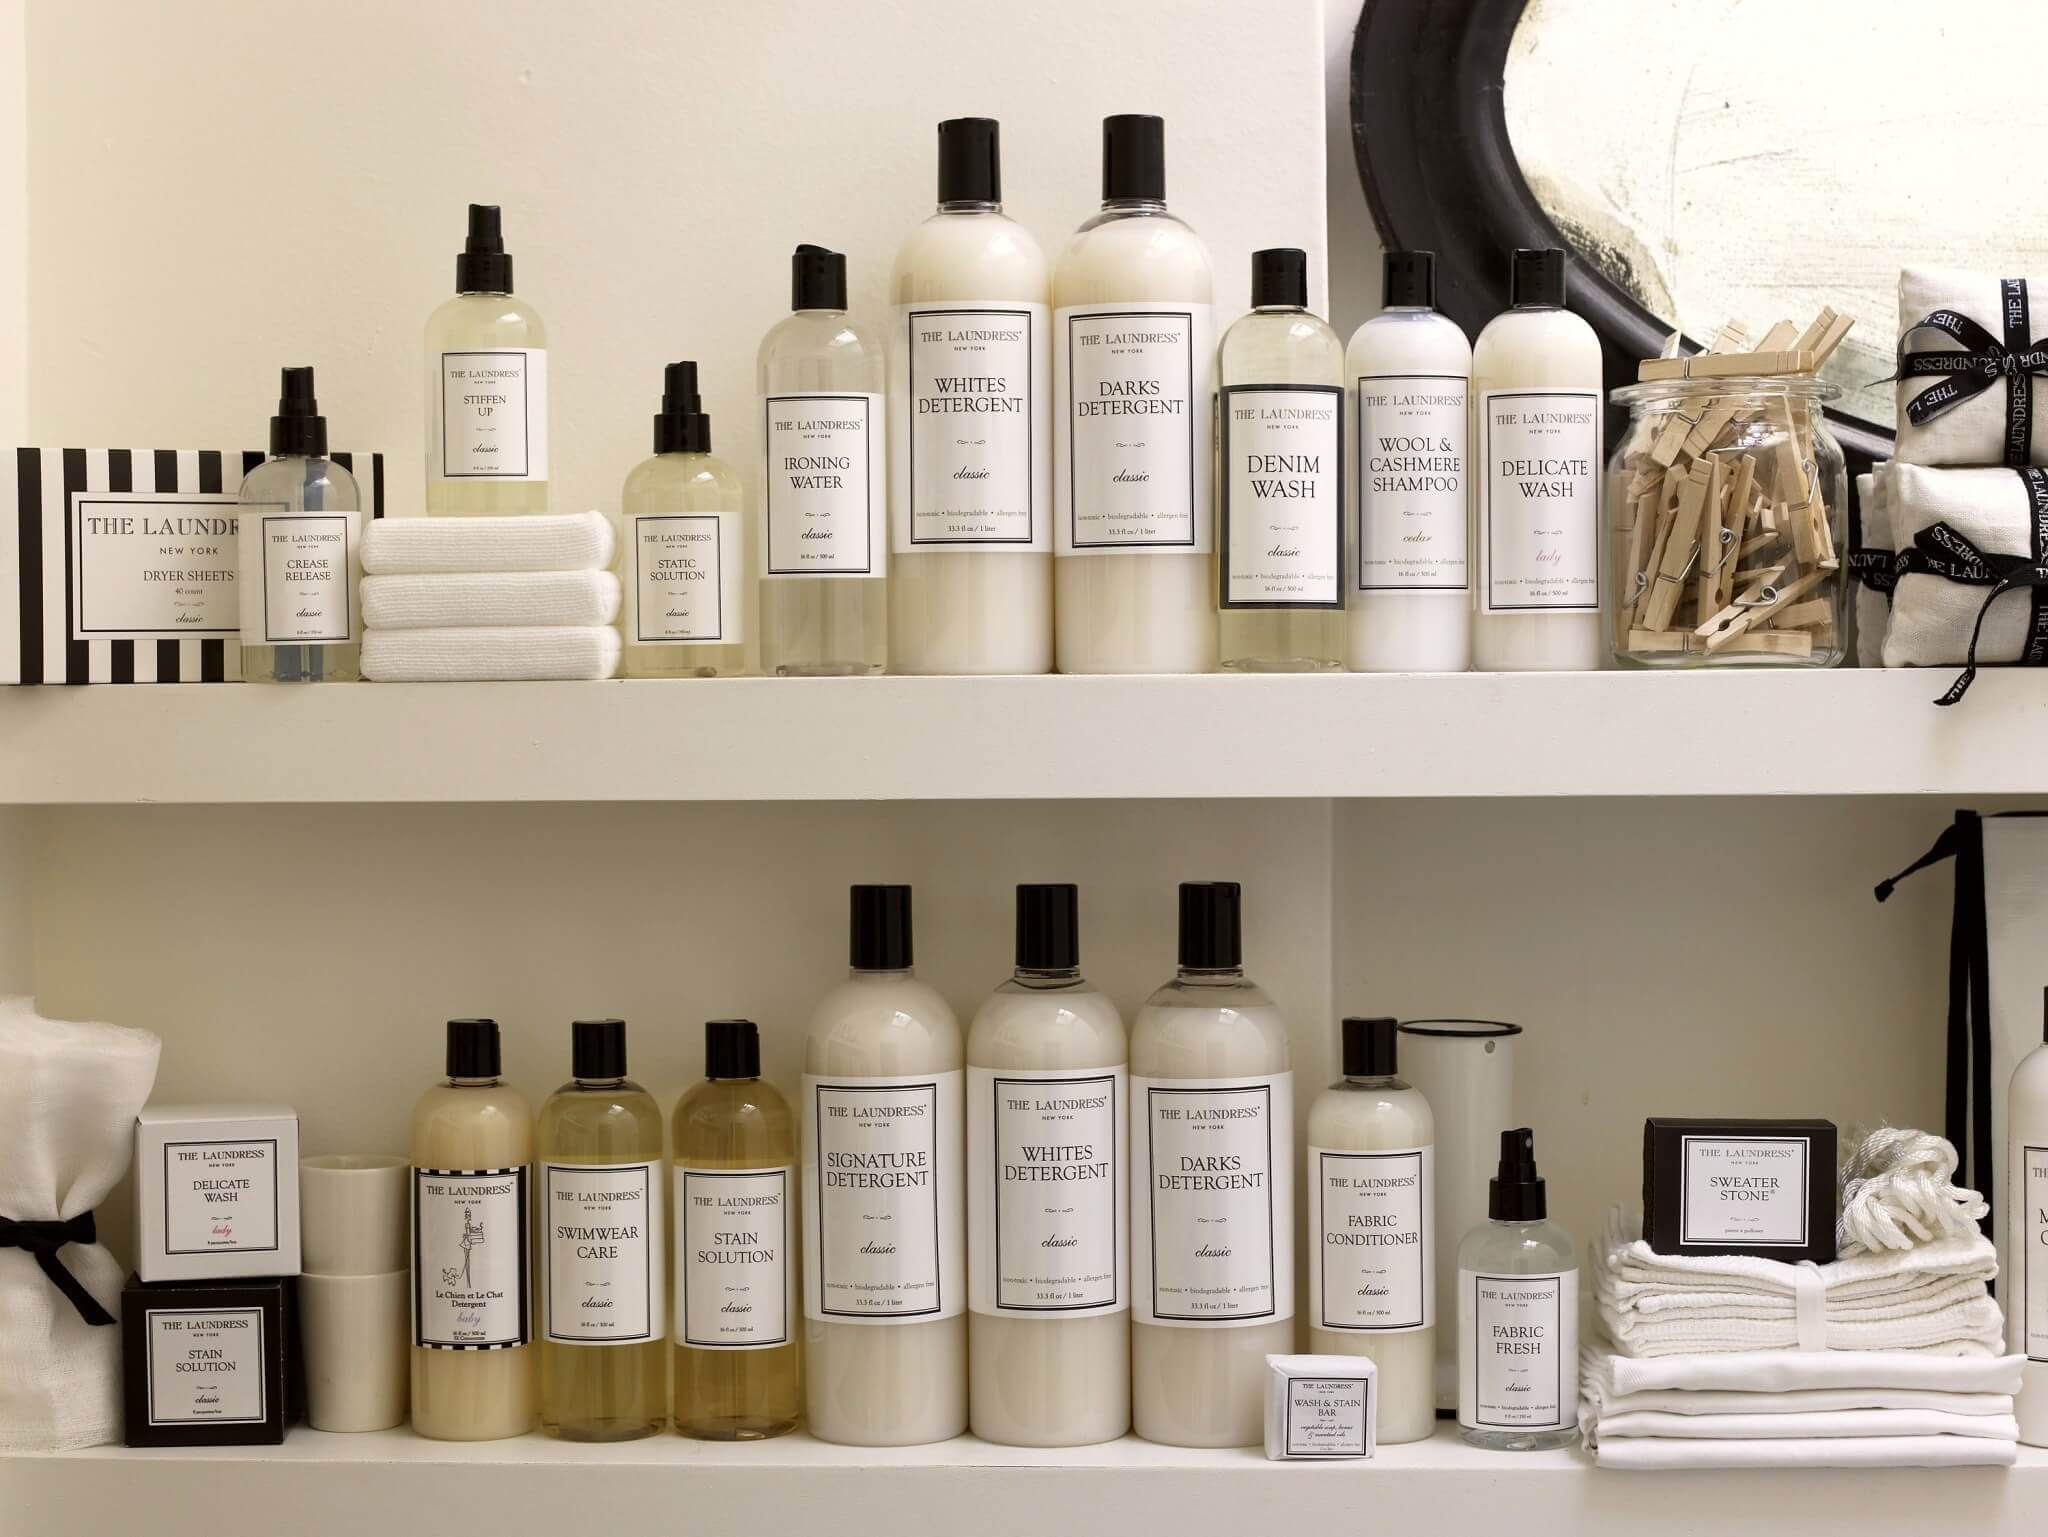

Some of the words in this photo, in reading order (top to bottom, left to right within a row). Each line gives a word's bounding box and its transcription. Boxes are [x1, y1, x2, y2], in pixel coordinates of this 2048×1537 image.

[1933, 313, 1963, 334] THE
[921, 332, 943, 343] THE
[948, 330, 1020, 341] LAUNDRESS
[1080, 335, 1100, 346] THE
[1106, 333, 1179, 344] LAUNDRESS
[469, 370, 520, 378] LAUNDRESS
[935, 378, 1007, 393] WHITES
[1100, 381, 1159, 396] DARKS
[464, 395, 506, 404] STIFFEN
[1924, 384, 1958, 405] THE
[919, 397, 1023, 414] DETERGENT
[1366, 396, 1387, 407] THE
[1393, 395, 1461, 406] LAUNDRESS
[478, 408, 493, 416] UP
[1079, 400, 1183, 416] DETERGENT
[1235, 409, 1255, 420] THE
[1261, 408, 1329, 420] LAUNDRESS
[1496, 414, 1517, 425] THE
[1523, 413, 1591, 424] LAUNDRESS
[775, 421, 793, 431] THE
[798, 420, 861, 430] LAUNDRESS
[473, 443, 498, 453] classic
[1379, 437, 1435, 452] WOOL
[1440, 438, 1453, 451] &
[785, 457, 850, 470] IRONING
[1248, 455, 1320, 473] DENIM
[1370, 457, 1460, 472] CASHMERE
[1502, 460, 1589, 477] DELICATE
[953, 465, 990, 479] classic
[1113, 469, 1149, 482] classic
[790, 476, 843, 488] WATER
[1374, 477, 1457, 492] SHAMPOO
[1251, 480, 1315, 498] WASH
[1519, 482, 1573, 498] WASH
[88, 518, 134, 534] THE
[292, 534, 342, 542] LAUNDRESS
[643, 535, 658, 543] THE
[662, 534, 711, 542] LAUNDRESS
[802, 528, 832, 539] classic
[1402, 530, 1432, 542] cedar
[160, 547, 183, 555] NEW
[190, 547, 218, 555] YORK
[1268, 544, 1300, 557] classic
[658, 559, 695, 568] STATIC
[1536, 549, 1561, 566] lady
[287, 560, 328, 569] CREASE
[144, 571, 184, 581] DRYER
[188, 570, 234, 581] SHEETS
[286, 571, 331, 582] RELEASE
[650, 571, 704, 582] SOLUTION
[176, 613, 203, 623] classic
[296, 608, 322, 617] classic
[1008, 1100, 1030, 1110] THE
[1036, 1097, 1105, 1111] LAUNDRESS
[828, 1107, 848, 1117] THE
[853, 1105, 924, 1118] LAUNDRESS
[1160, 1109, 1181, 1119] THE
[1187, 1107, 1258, 1120] LAUNDRESS
[178, 1152, 198, 1160] THE
[203, 1150, 264, 1160] LAUNDRESS
[1022, 1145, 1092, 1161] WHITES
[1699, 1149, 1720, 1157] THE
[1726, 1149, 1792, 1158] LAUNDRESS
[828, 1152, 927, 1168] SIGNATURE
[1181, 1156, 1240, 1171] DARKS
[1005, 1162, 1108, 1181] DETERGENT
[2032, 1168, 2048, 1178] TH
[193, 1179, 250, 1191] DELICATE
[827, 1171, 928, 1188] DETERGENT
[1159, 1172, 1263, 1190] DETERGENT
[1329, 1178, 1348, 1187] THE
[1353, 1176, 1416, 1188] LAUNDRESS
[1711, 1177, 1779, 1188] SWEATER
[426, 1185, 444, 1195] THE
[449, 1184, 511, 1195] LAUNDRESS
[204, 1192, 238, 1202] WASH
[556, 1192, 574, 1201] THE
[578, 1191, 641, 1202] LAUNDRESS
[693, 1197, 713, 1206] THE
[718, 1196, 779, 1206] LAUNDRESS
[1349, 1215, 1397, 1227] FABRIC
[558, 1226, 638, 1240] SWIMWEAR
[714, 1232, 758, 1245] STAIN
[1327, 1232, 1418, 1246] CONDITIONER
[1042, 1233, 1077, 1247] classic
[577, 1246, 618, 1258] CARE
[860, 1241, 896, 1254] classic
[1195, 1244, 1231, 1257] classic
[697, 1250, 773, 1263] SOLUTION
[445, 1291, 465, 1299] Chien
[1358, 1284, 1389, 1296] classic
[1481, 1290, 1497, 1299] THE
[1501, 1290, 1554, 1300] LAUNDRESS
[451, 1299, 486, 1309] Detergent
[582, 1296, 614, 1308] classic
[721, 1302, 752, 1312] classic
[162, 1322, 182, 1330] THE
[187, 1320, 248, 1329] LAUNDRESS
[455, 1311, 480, 1327] baby
[1493, 1326, 1544, 1338] FABRIC
[1496, 1342, 1540, 1354] FRESH
[189, 1350, 222, 1359] STAIN
[176, 1361, 236, 1372] SOLUTION
[1505, 1383, 1531, 1392] classic
[195, 1395, 219, 1403] classic
[1295, 1399, 1321, 1407] WASH
[1319, 1408, 1336, 1416] BAR
